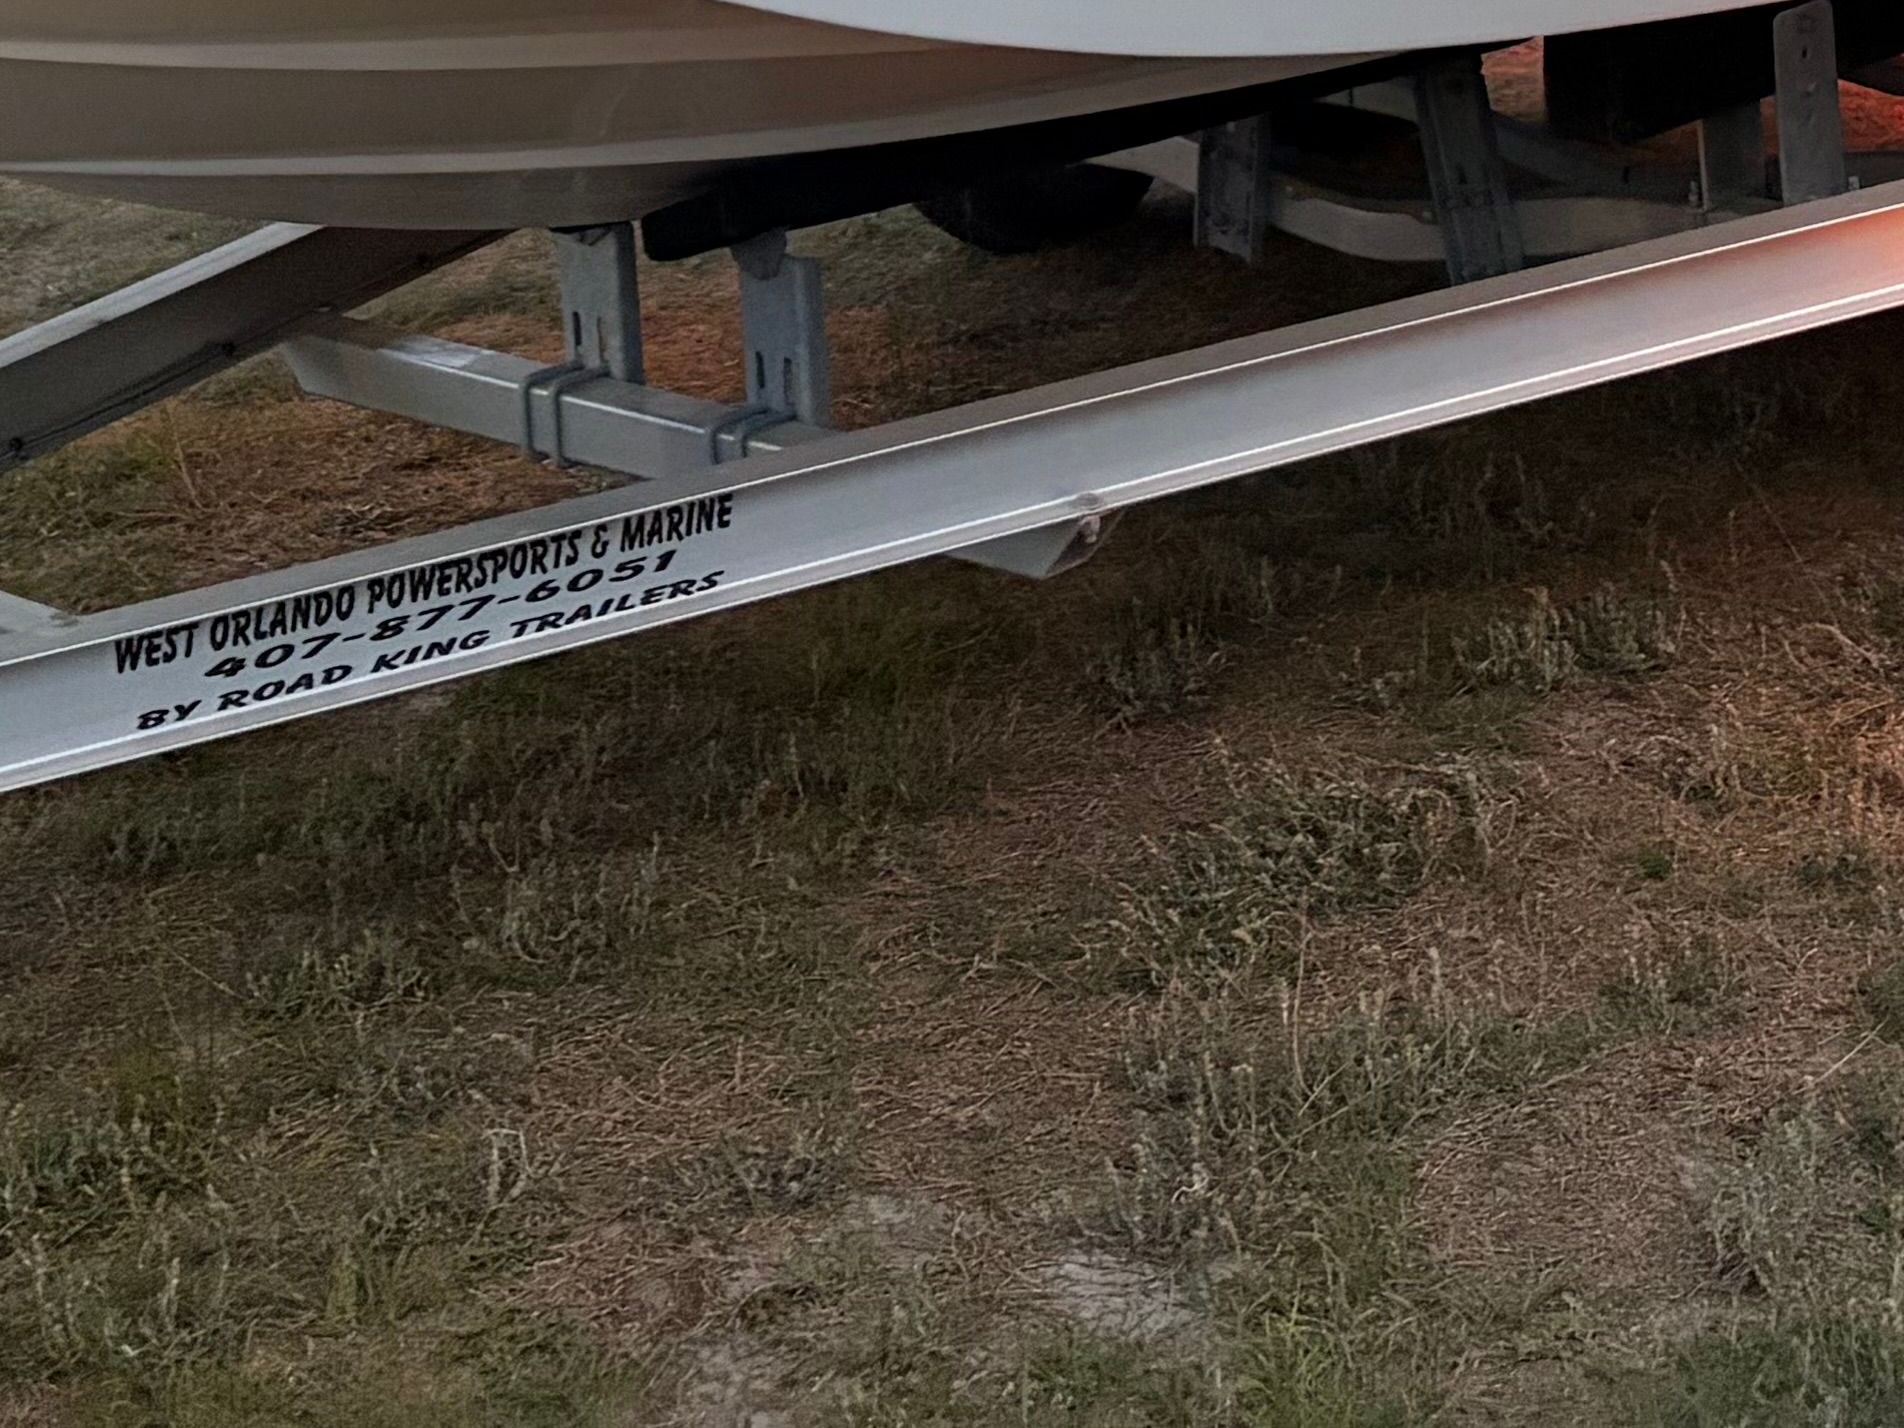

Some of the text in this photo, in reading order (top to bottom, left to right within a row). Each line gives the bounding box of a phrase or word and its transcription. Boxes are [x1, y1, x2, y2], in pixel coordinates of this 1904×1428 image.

[114, 493, 734, 674] WEST ORLANDO POWERSPORTS & MARINE
[136, 569, 726, 730] BY ROAD KING TRAILERS
[204, 548, 678, 678] 407-877-6051
